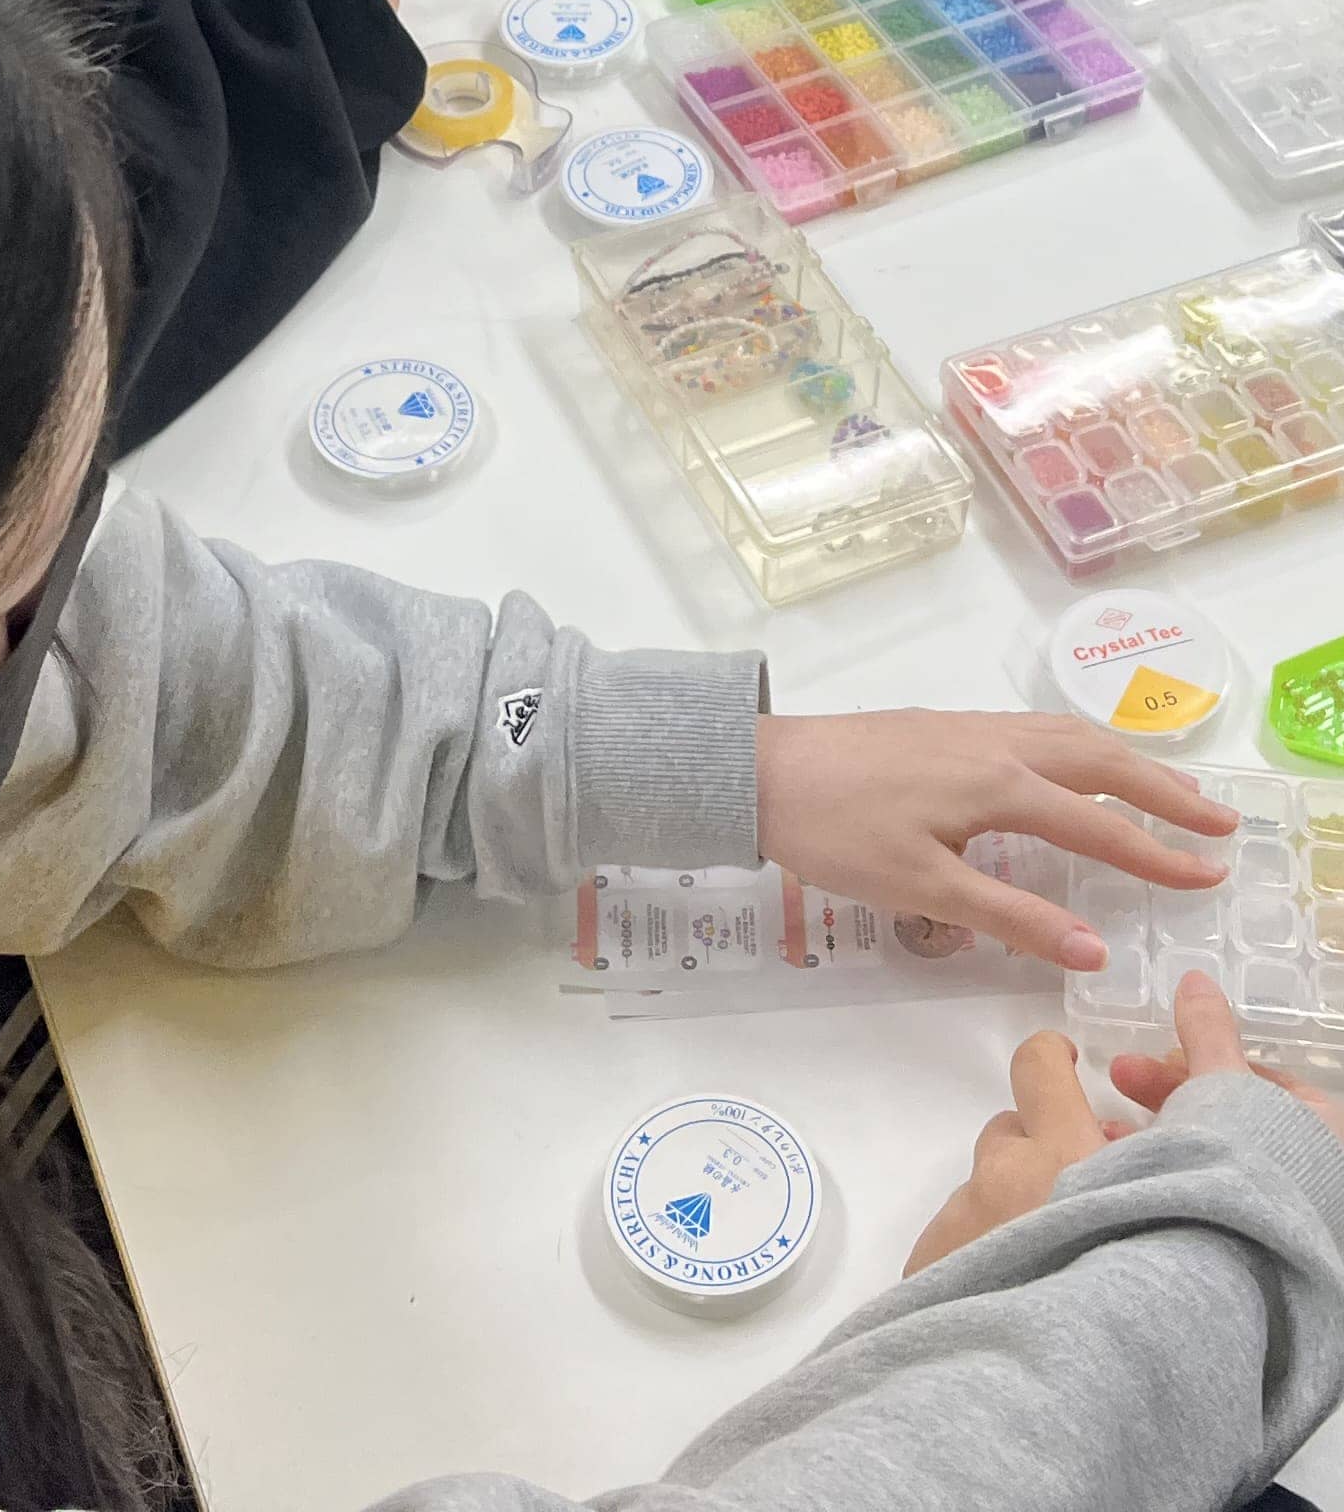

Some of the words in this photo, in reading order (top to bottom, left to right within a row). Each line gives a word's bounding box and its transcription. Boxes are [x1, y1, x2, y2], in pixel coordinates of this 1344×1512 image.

[379, 360, 449, 383] STRONG
[444, 380, 458, 392] &
[430, 389, 471, 458] STRETCHY
[1072, 632, 1145, 662] Crystal
[1145, 624, 1183, 643] Tec
[1144, 691, 1178, 711] 0.5
[711, 1103, 746, 1121] 100%
[723, 1148, 743, 1166] 0.3
[616, 1151, 662, 1259] STRETCHY
[662, 1253, 679, 1270] &
[683, 1248, 775, 1281] STRONG
